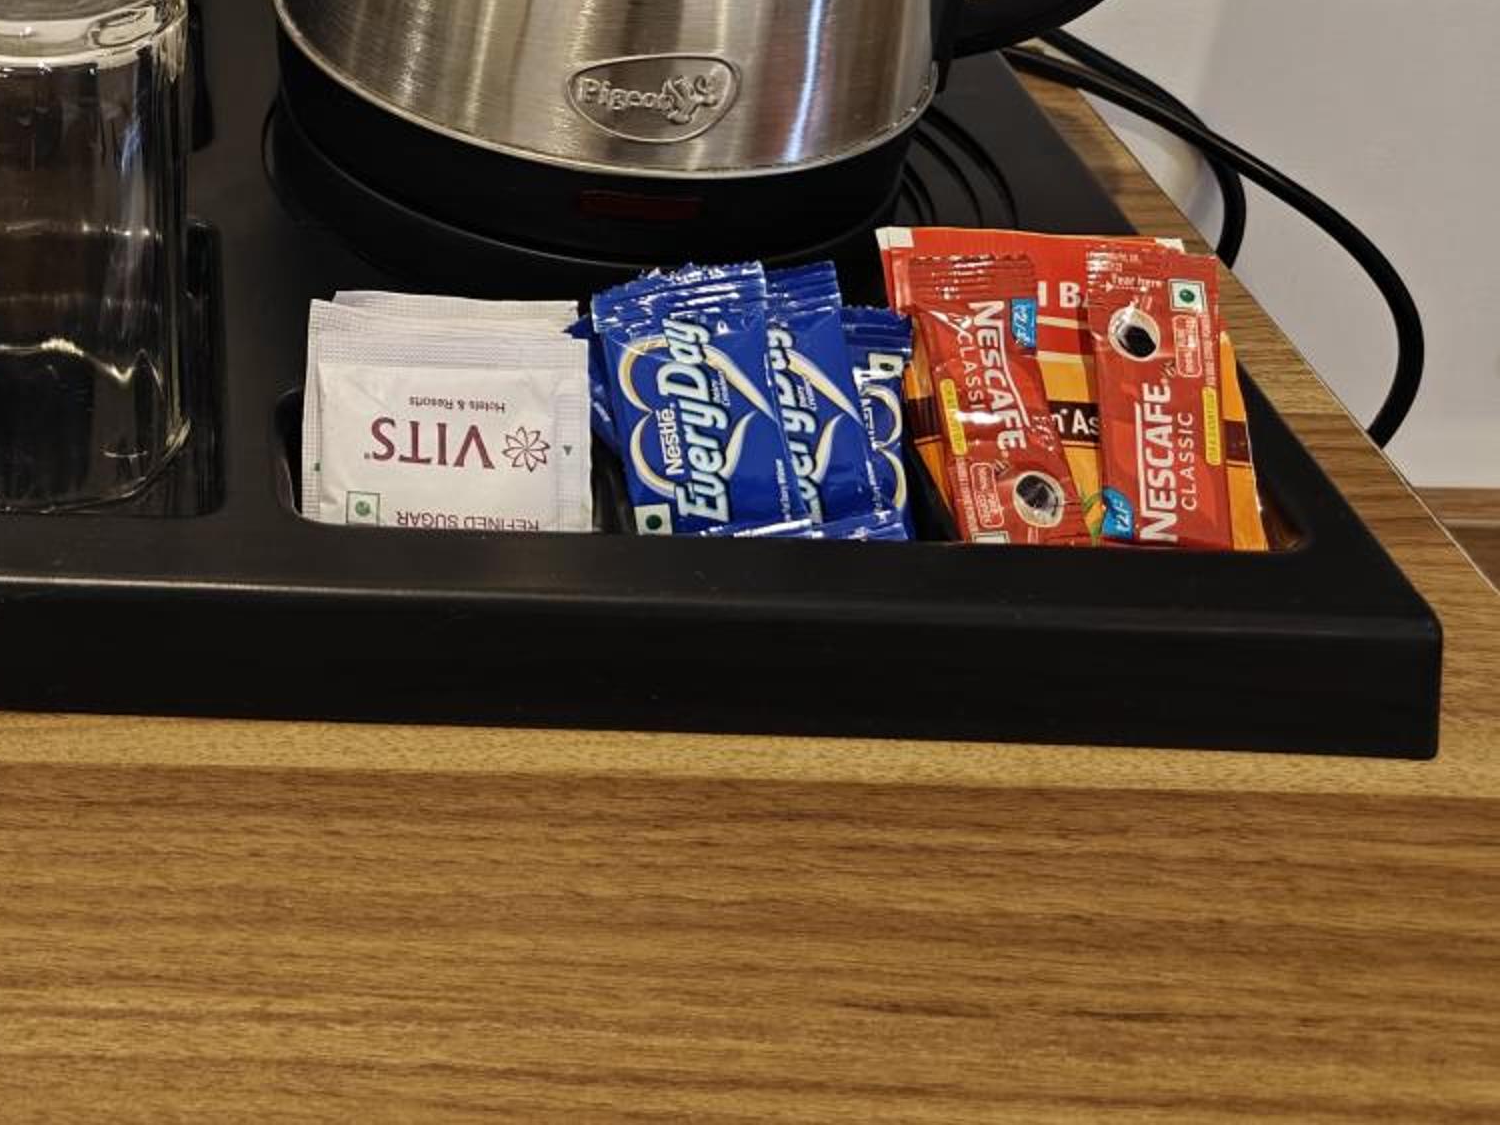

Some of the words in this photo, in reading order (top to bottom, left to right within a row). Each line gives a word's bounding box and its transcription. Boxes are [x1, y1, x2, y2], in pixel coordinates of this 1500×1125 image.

[957, 330, 988, 424] CLASSI
[371, 417, 496, 470] VITS
[1177, 411, 1198, 512] CLASSIC
[396, 511, 461, 530] SUGAR
